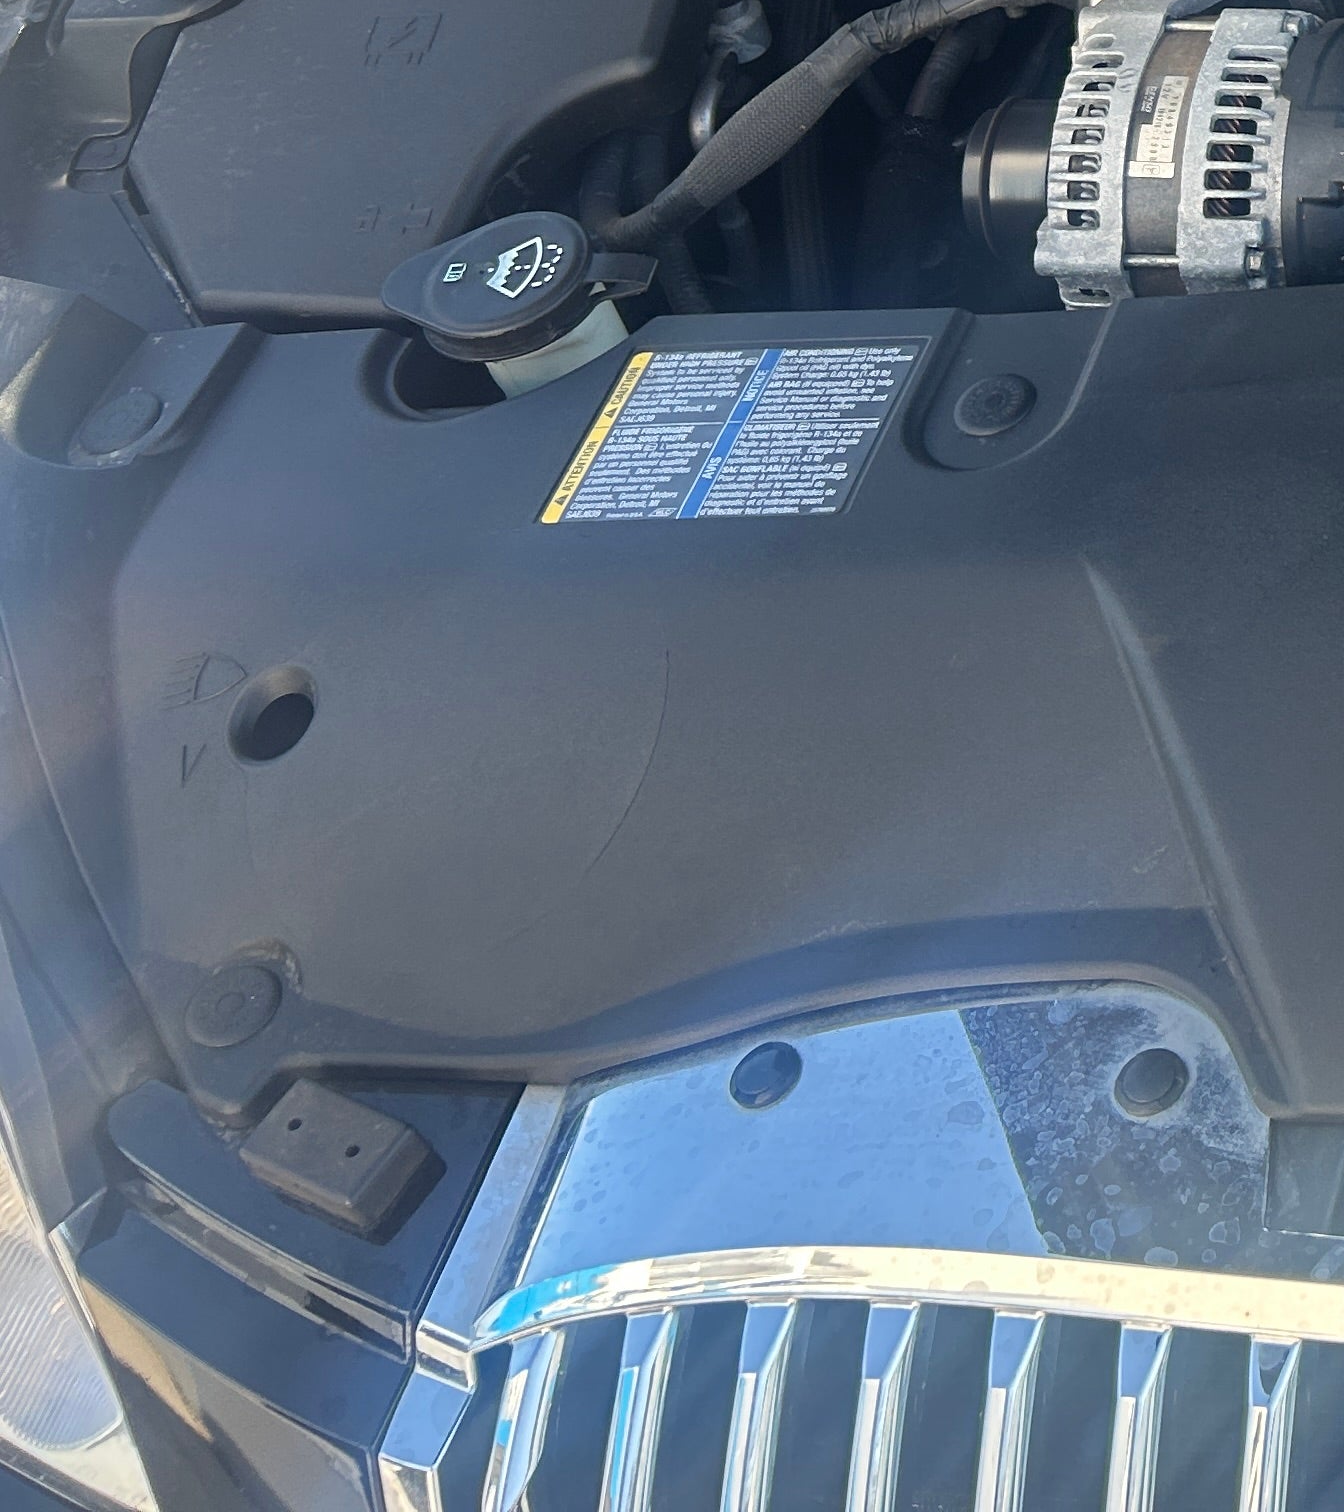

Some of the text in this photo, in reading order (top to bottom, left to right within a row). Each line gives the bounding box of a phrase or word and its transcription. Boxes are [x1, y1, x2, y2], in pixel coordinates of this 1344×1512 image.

[610, 368, 640, 405] CAUTION
[741, 370, 769, 401] NOTICE
[561, 441, 599, 491] ATTENTION
[700, 457, 723, 480] AVIS
